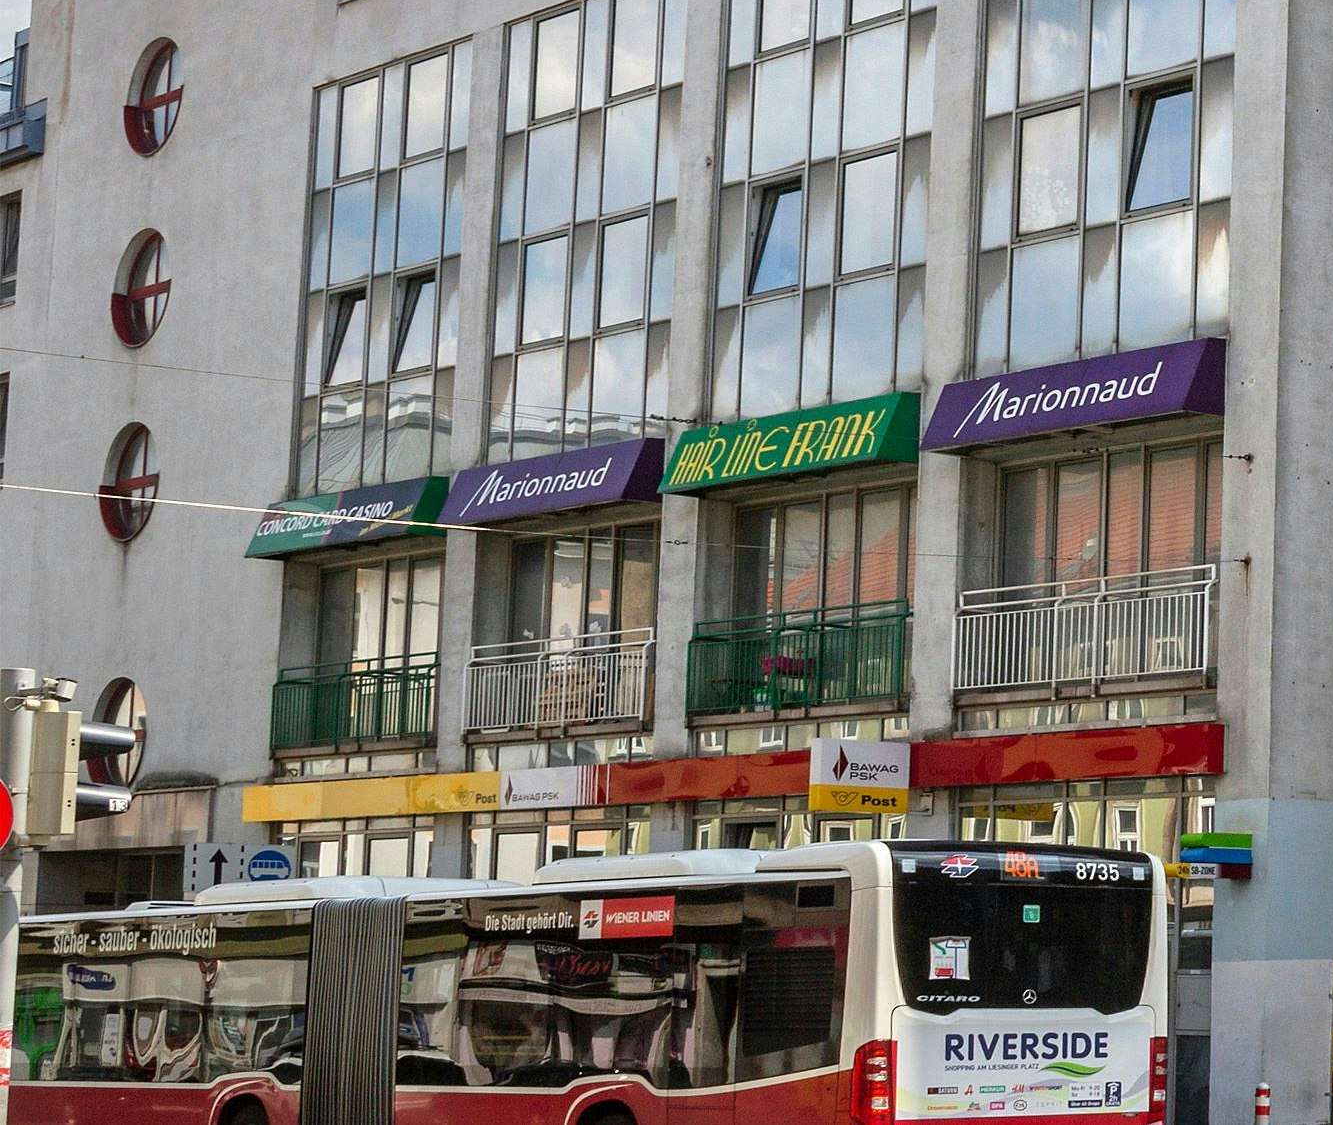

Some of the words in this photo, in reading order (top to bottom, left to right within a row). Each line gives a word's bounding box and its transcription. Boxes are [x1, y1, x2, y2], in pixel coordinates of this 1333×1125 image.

[954, 361, 1163, 438] Marionnaud
[780, 409, 885, 469] FRANK
[460, 458, 612, 517] Marionnaud
[256, 512, 313, 537] CONCORD
[313, 507, 348, 528] CARD
[347, 500, 393, 523] CASINO
[850, 763, 899, 773] BAWAG
[850, 772, 878, 781] PSK
[475, 794, 497, 804] Post
[512, 793, 541, 802] BAWAG
[861, 795, 898, 807] Post
[1076, 862, 1120, 881] 8735
[1190, 866, 1216, 875] SB-ZONE
[485, 915, 499, 931] Die
[502, 913, 525, 931] Stadt
[527, 912, 556, 934] gehört
[558, 911, 575, 929] Dir.
[606, 911, 640, 924] WIENER
[642, 910, 670, 923] LINIEN
[54, 930, 88, 954] sicher
[99, 928, 140, 952] sauber
[150, 923, 217, 955] ökologisch
[916, 994, 981, 1002] CITARO
[944, 1032, 1109, 1061] RIVERSIDE
[944, 1064, 976, 1072] SHOPPING
[988, 1063, 1018, 1071] LIESINGER
